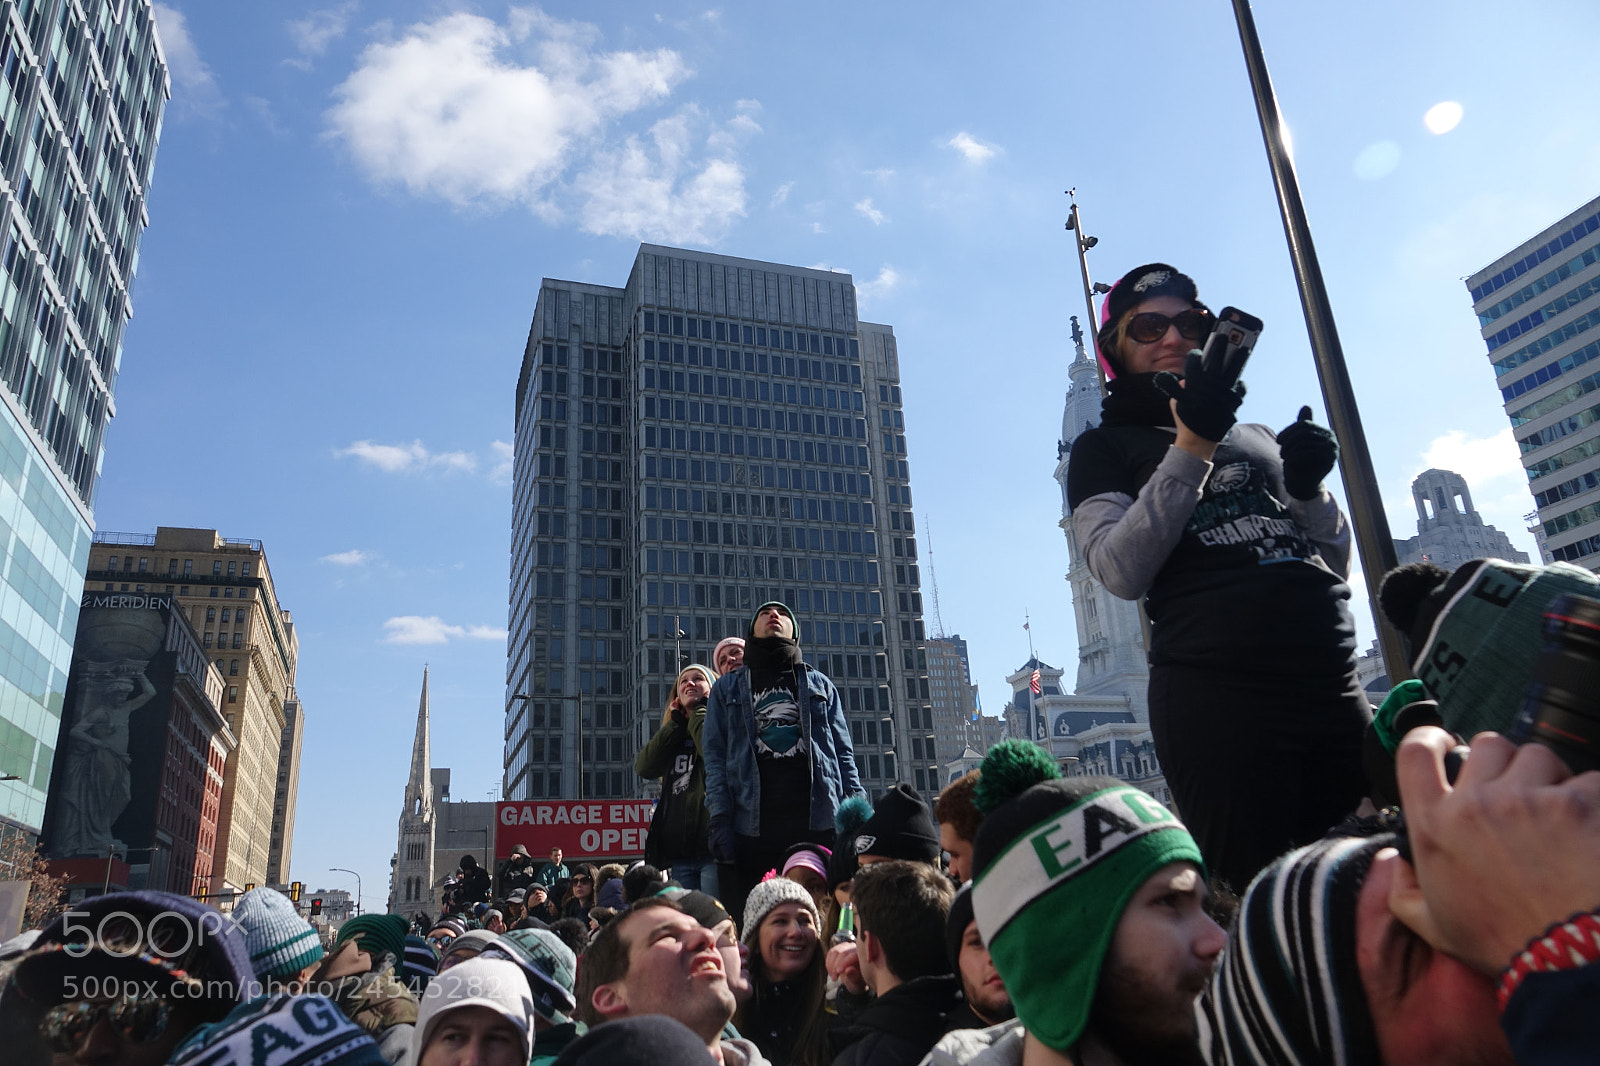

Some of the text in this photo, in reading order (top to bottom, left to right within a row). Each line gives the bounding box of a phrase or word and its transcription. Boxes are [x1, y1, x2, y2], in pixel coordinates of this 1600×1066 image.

[1197, 513, 1300, 547] CHAMPION
[93, 594, 171, 610] MERIDIEN
[500, 805, 603, 826] GARAGE
